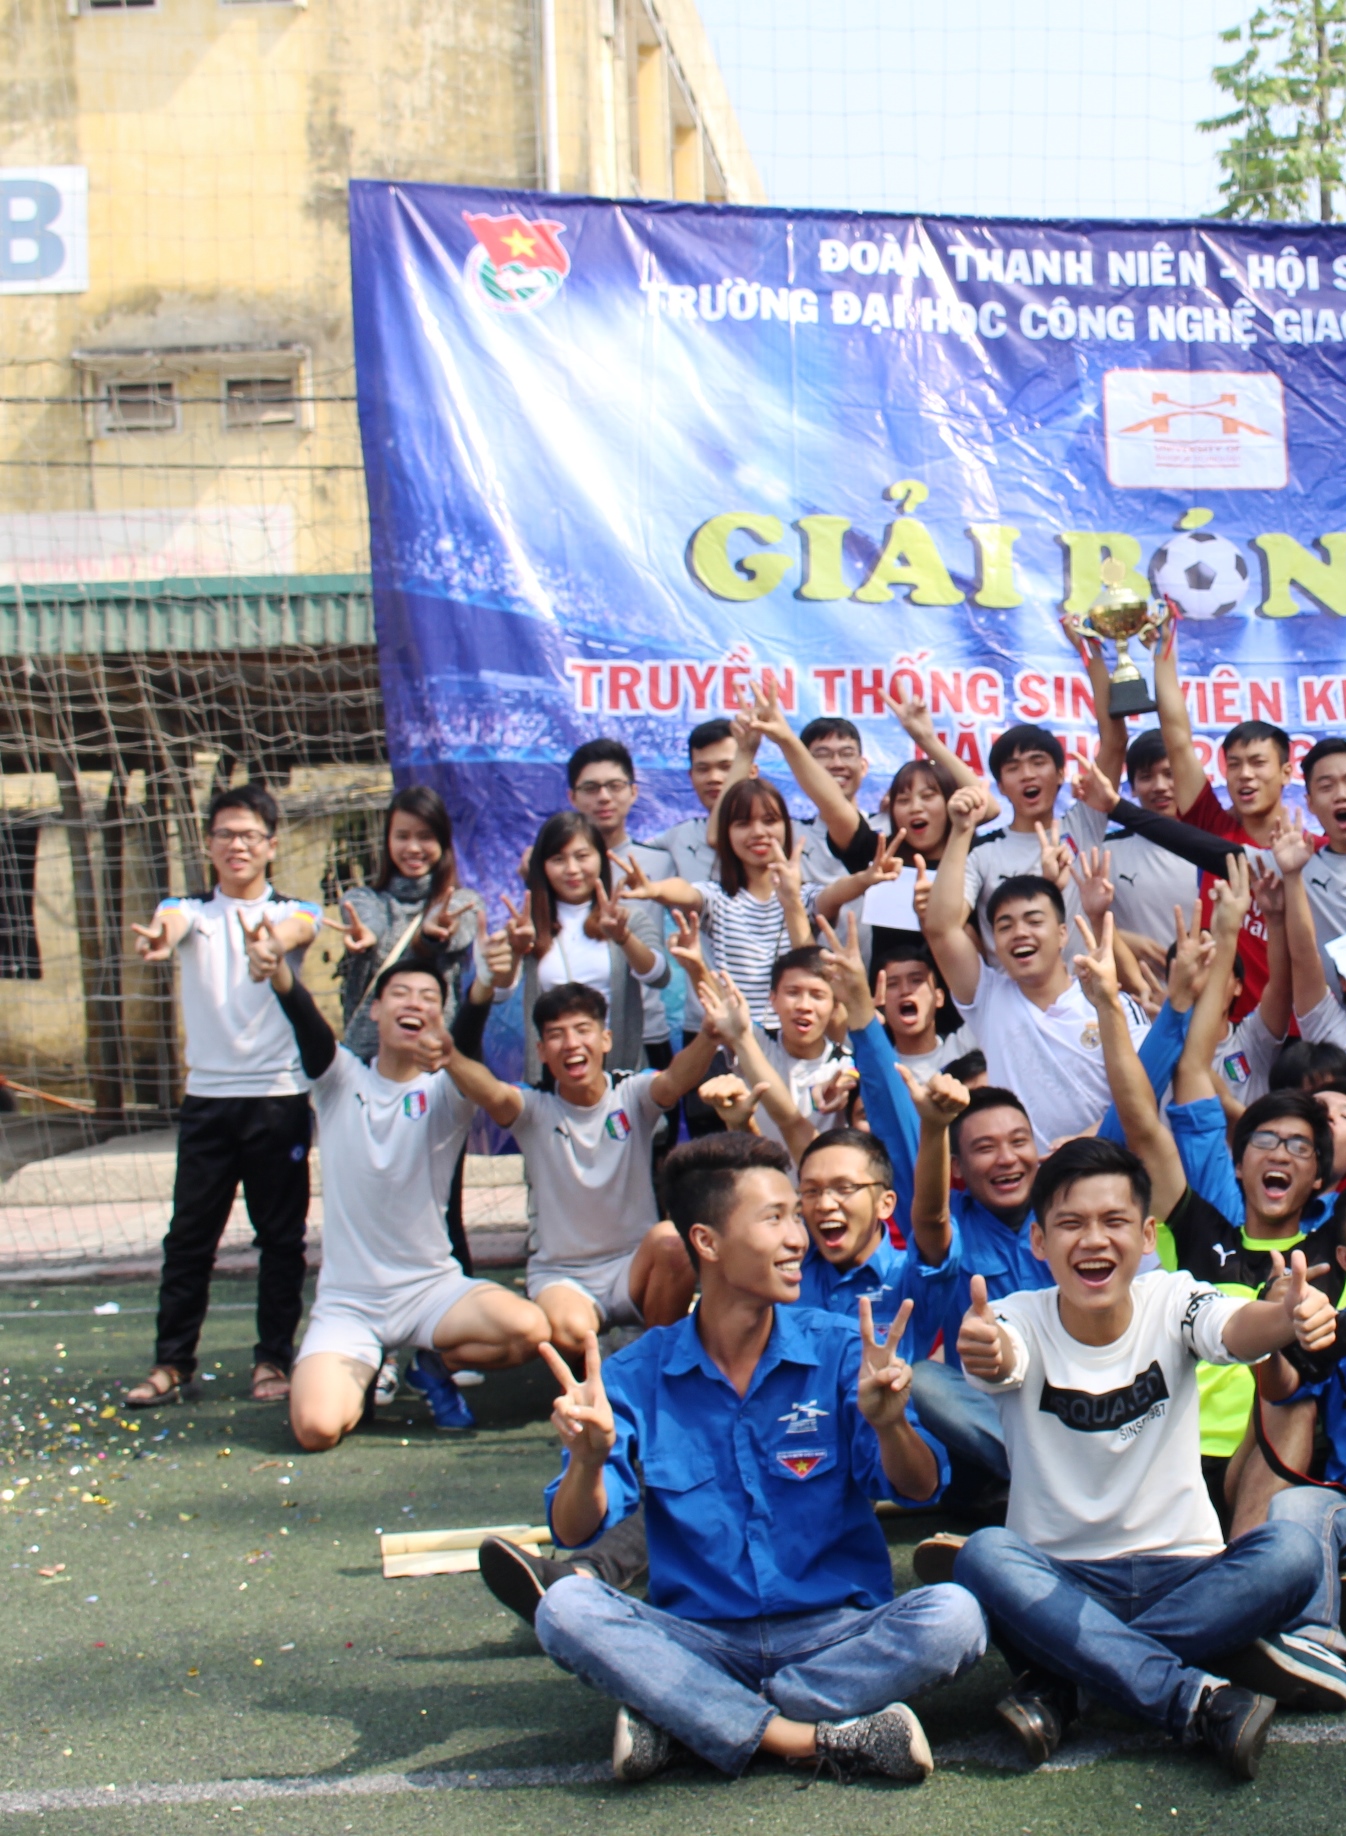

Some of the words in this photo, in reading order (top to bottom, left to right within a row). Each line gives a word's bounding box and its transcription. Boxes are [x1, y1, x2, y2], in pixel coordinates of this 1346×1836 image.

[818, 233, 938, 280] ĐOÀN
[947, 244, 1092, 286] THANH
[1108, 241, 1207, 287] NIÊN
[1246, 246, 1320, 298] HỘI
[641, 277, 819, 323] TRƯỜNG
[830, 290, 907, 335] ĐẠI
[920, 296, 1008, 344] HỌC
[1019, 295, 1134, 342] CÔNG
[1148, 298, 1259, 352] NGHỆ
[688, 480, 1023, 610] GIẢI
[571, 644, 795, 712] TRUYỀN
[813, 651, 1000, 717] THỐNG
[1020, 674, 1140, 722] SIN
